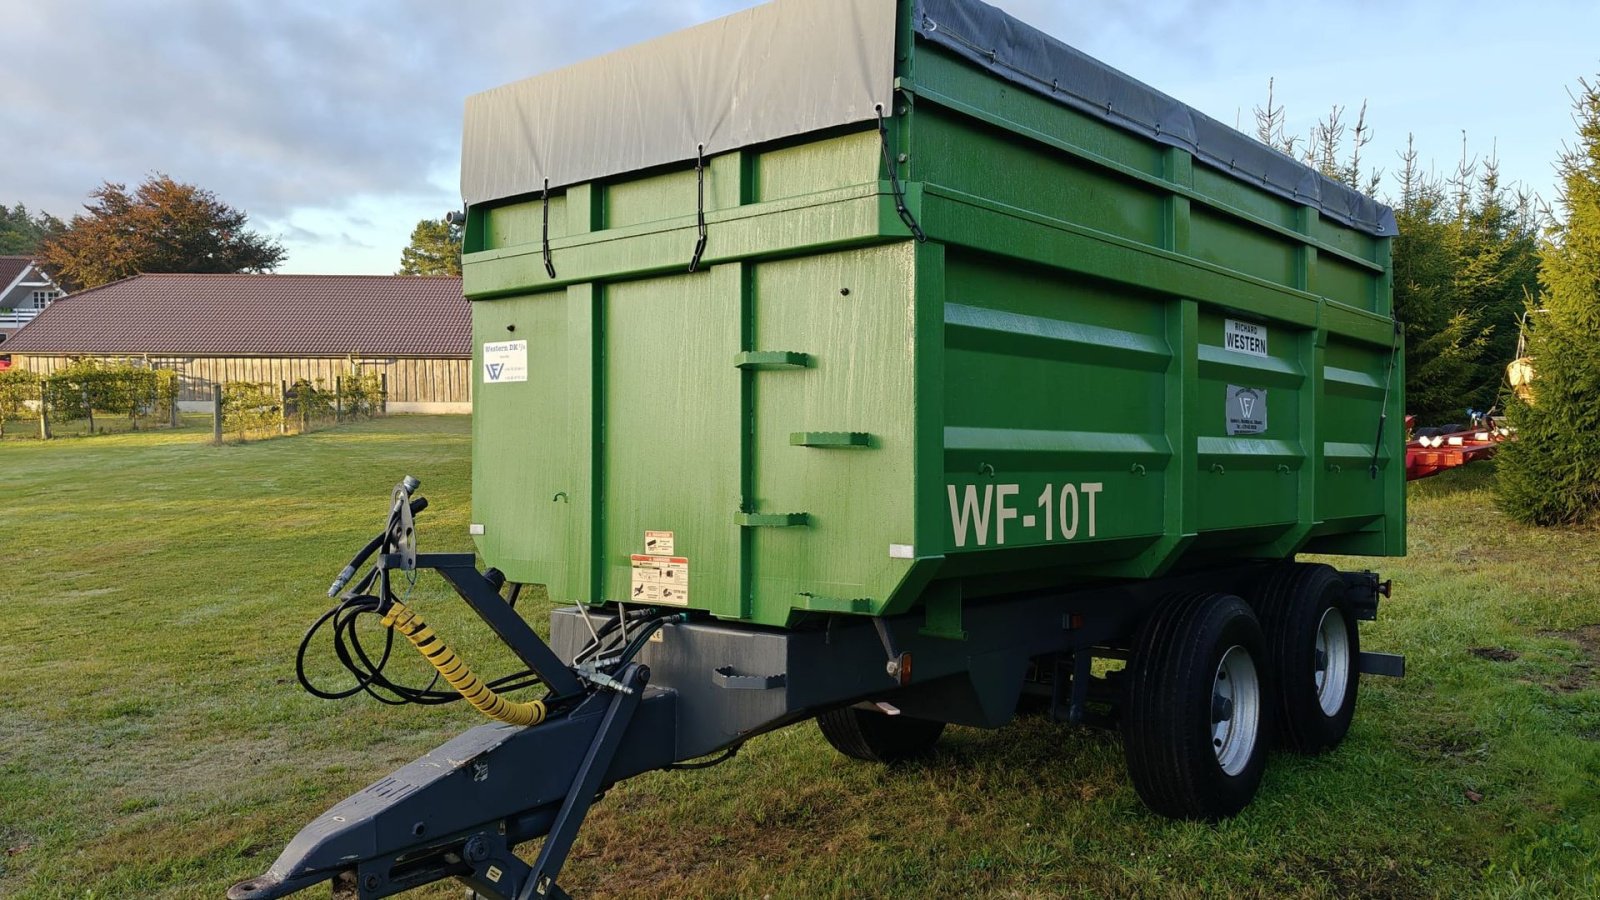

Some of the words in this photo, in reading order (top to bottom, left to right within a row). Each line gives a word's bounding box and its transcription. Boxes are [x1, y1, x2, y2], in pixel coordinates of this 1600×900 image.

[1234, 321, 1258, 335] RICHARD
[1226, 332, 1266, 354] WESTERN
[947, 482, 1103, 547] WF-10T
